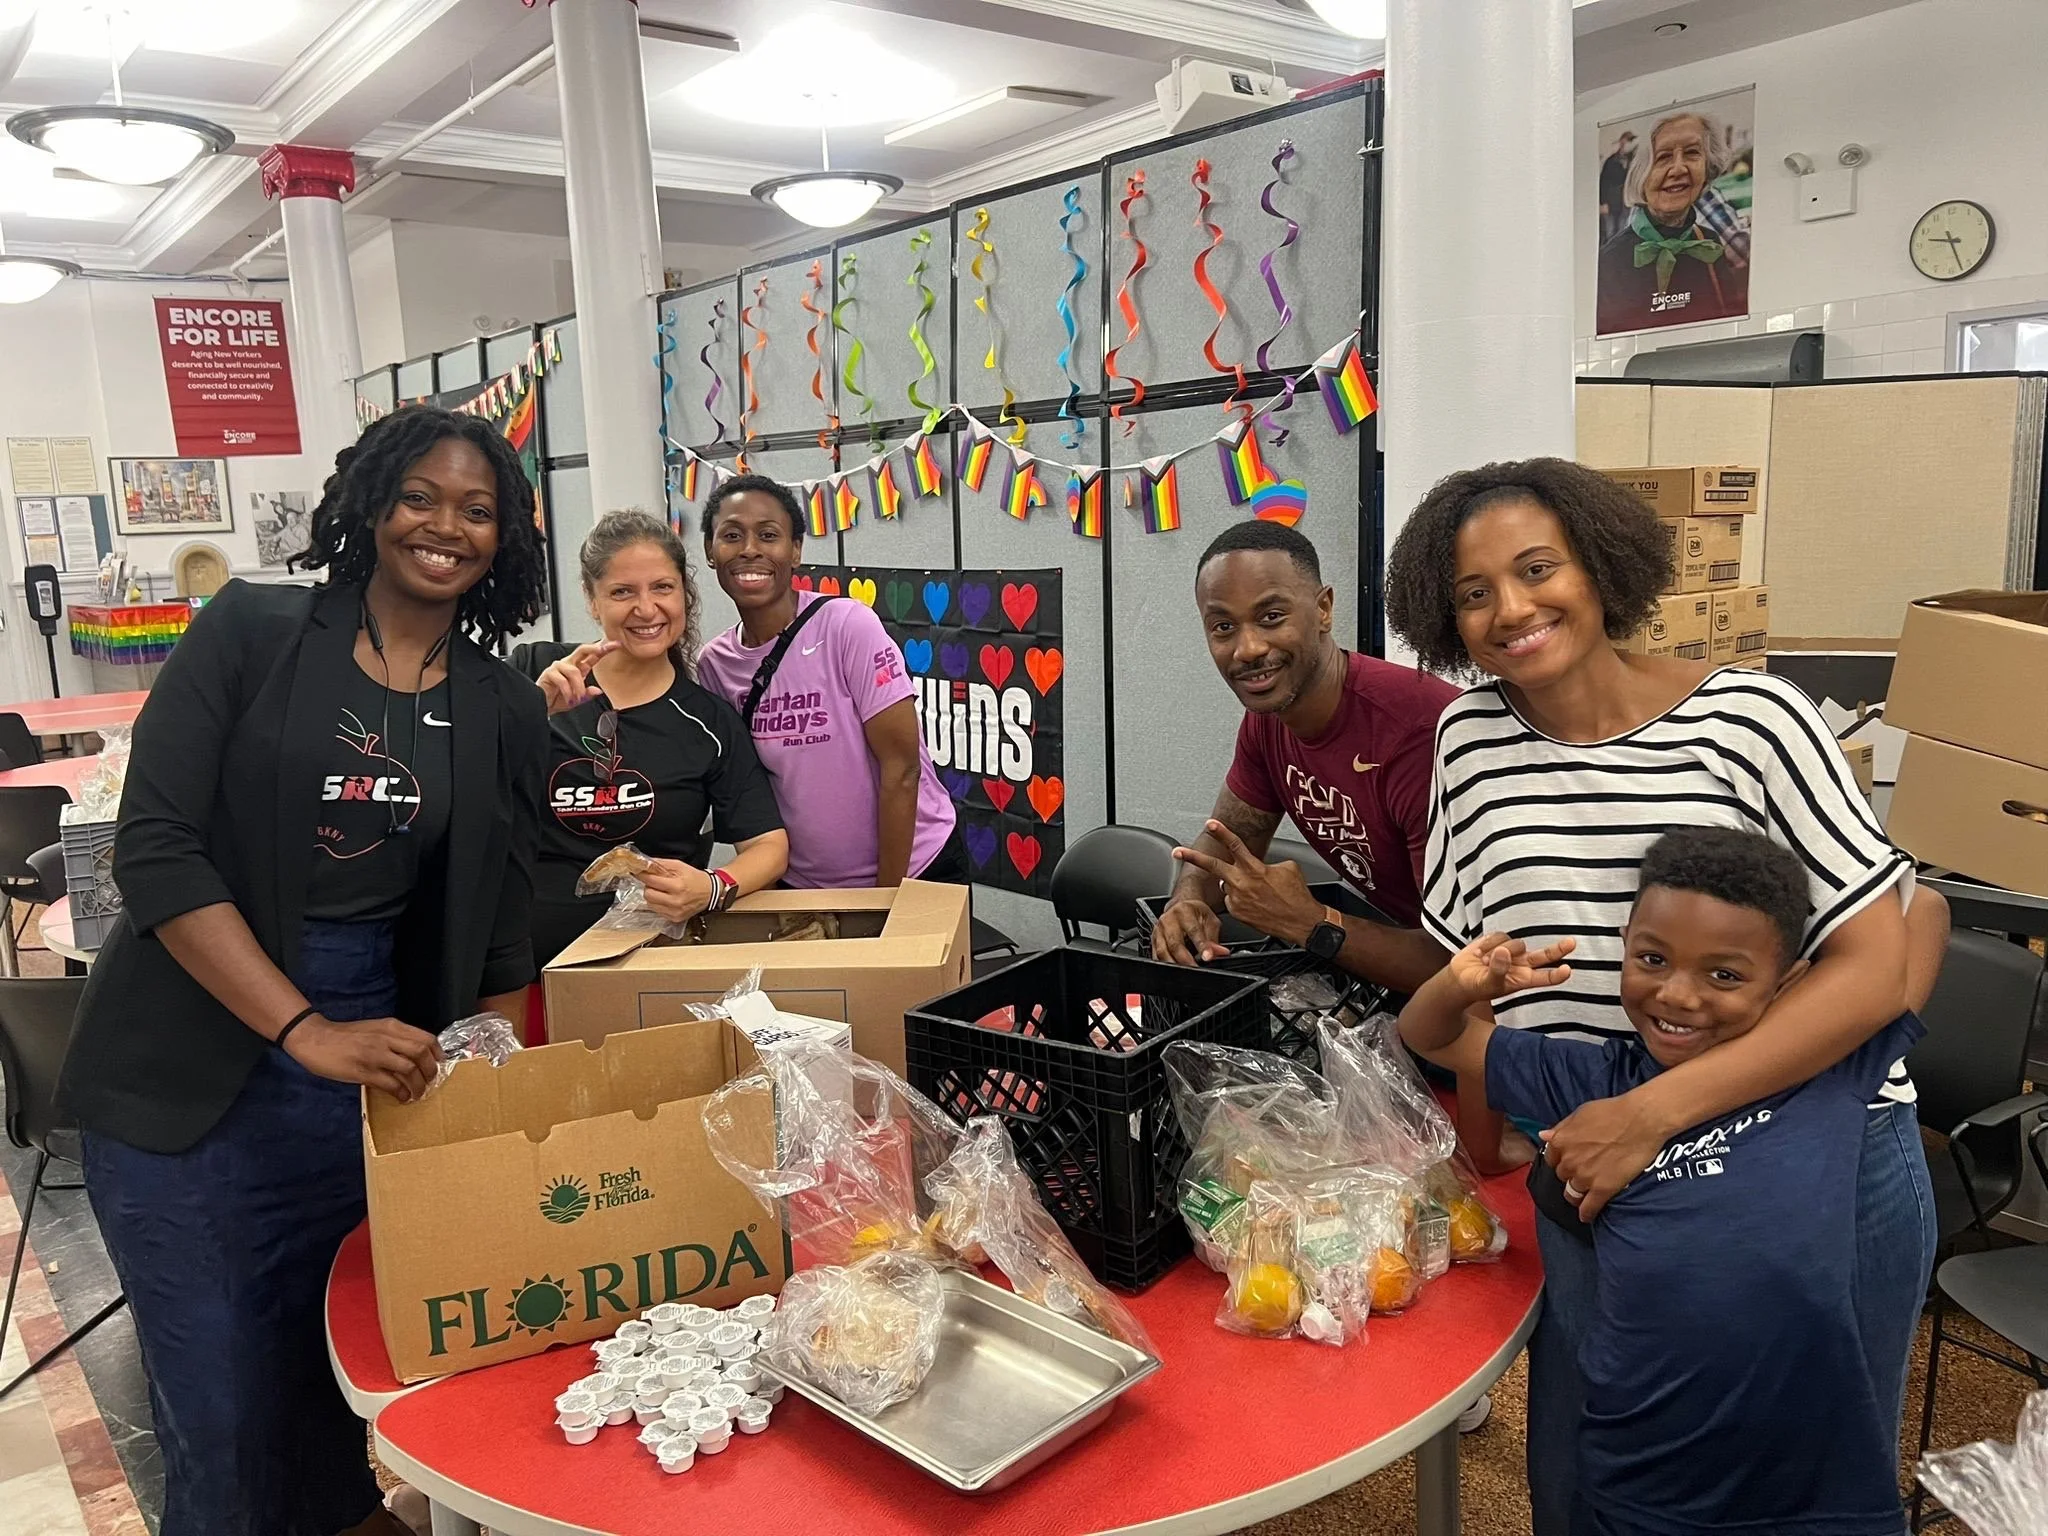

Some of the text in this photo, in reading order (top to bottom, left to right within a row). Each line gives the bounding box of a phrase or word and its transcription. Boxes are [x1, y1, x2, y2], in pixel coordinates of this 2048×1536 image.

[1652, 292, 1691, 305] ENCORE
[169, 308, 274, 326] ENCORE
[168, 328, 280, 346] FOR LIFE
[191, 350, 213, 359] Aging
[188, 372, 227, 380] financially
[239, 383, 274, 391] creativity
[783, 734, 831, 747] Run Club
[550, 783, 654, 807] SSRC
[317, 826, 345, 842] BKNY
[598, 1166, 642, 1189] Fresh
[1657, 1167, 1682, 1181] MLB
